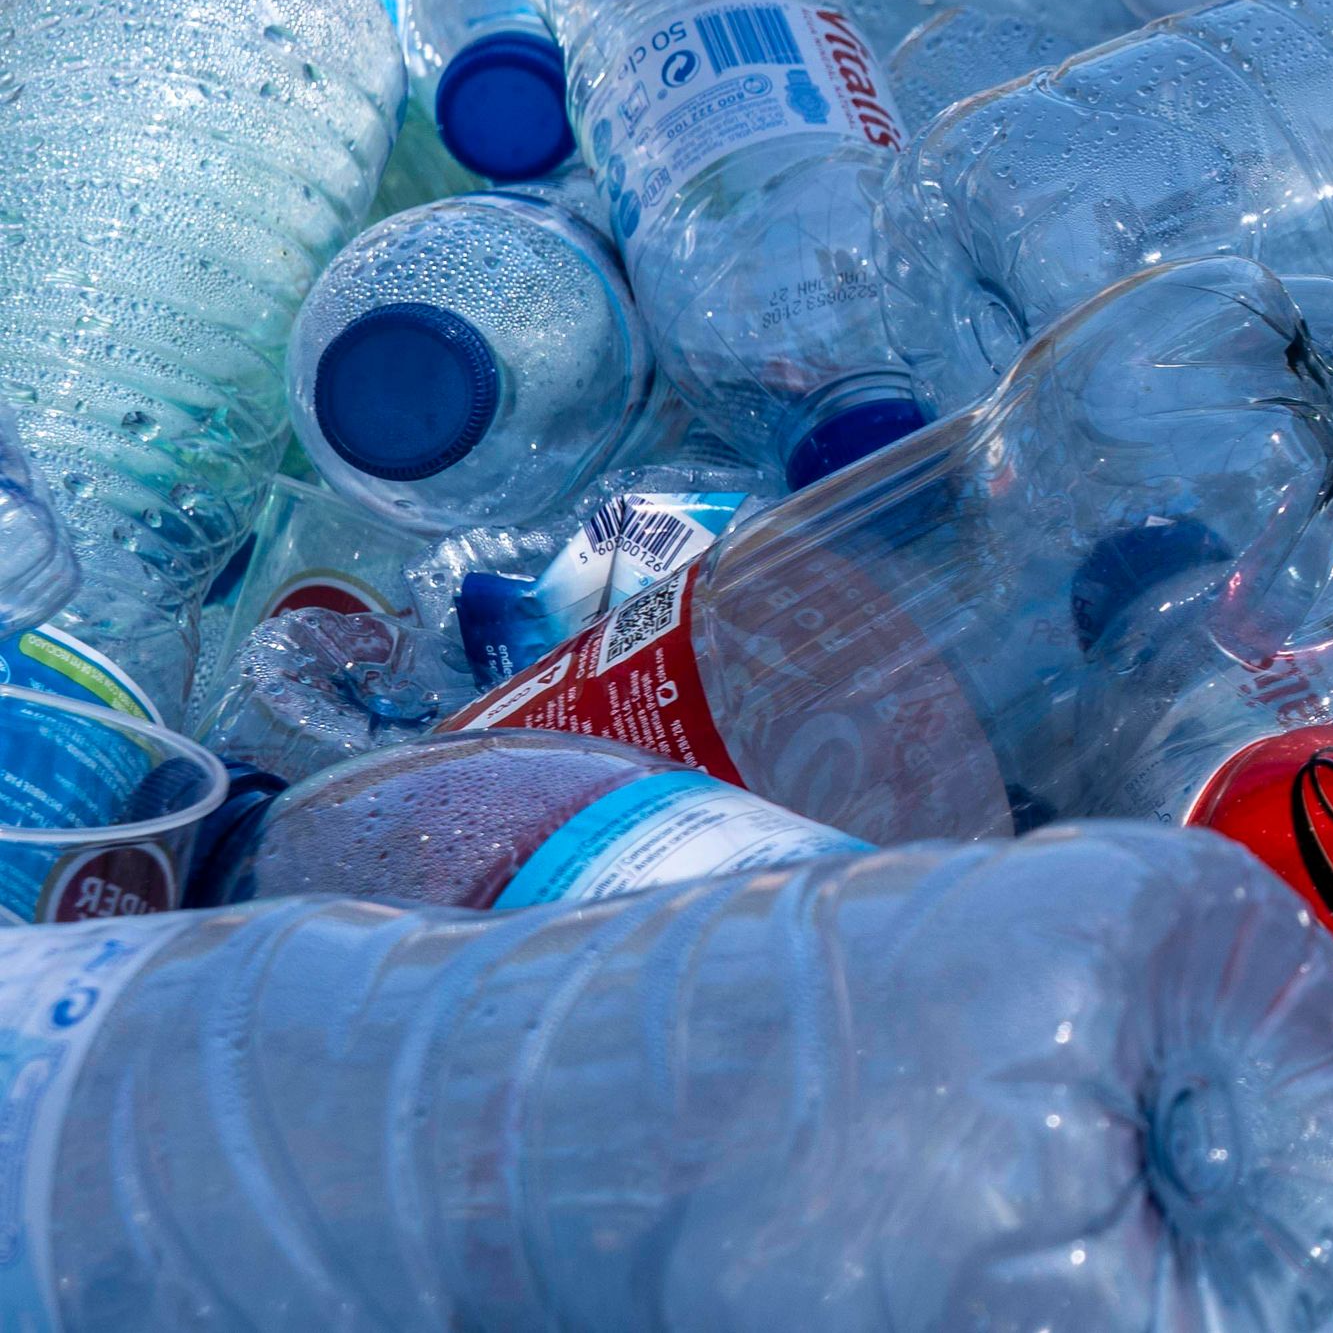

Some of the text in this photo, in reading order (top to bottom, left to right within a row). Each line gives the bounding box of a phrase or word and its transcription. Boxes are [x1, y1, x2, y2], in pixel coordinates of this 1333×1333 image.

[651, 18, 689, 53] 50
[816, 9, 902, 152] Vitalis
[666, 91, 744, 139] 800 222 100
[578, 551, 588, 564] 5
[485, 643, 496, 657] of
[669, 719, 684, 736] 286
[675, 735, 690, 752] 286
